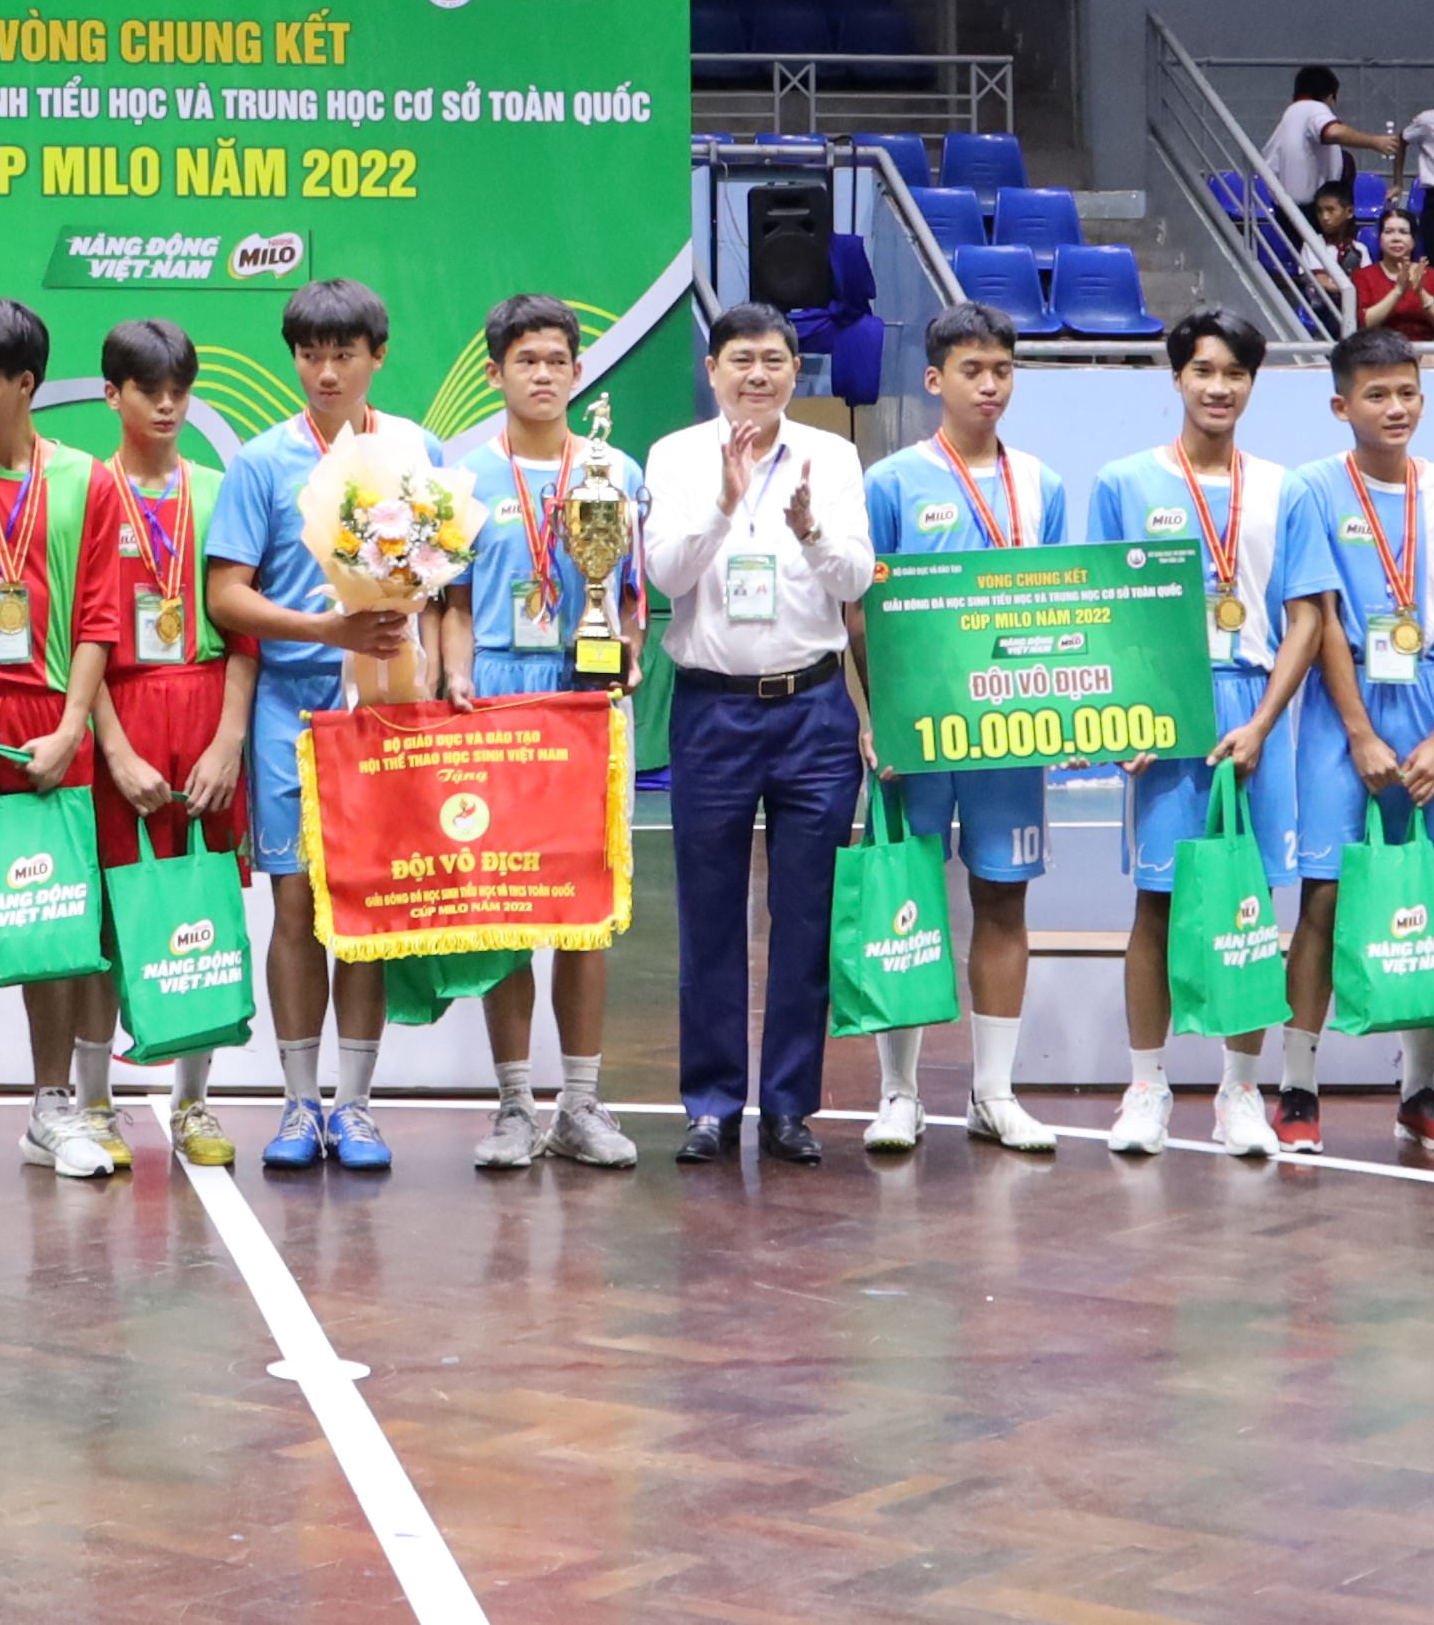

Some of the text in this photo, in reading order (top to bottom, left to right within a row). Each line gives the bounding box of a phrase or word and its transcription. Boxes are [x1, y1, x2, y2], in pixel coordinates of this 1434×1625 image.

[121, 20, 262, 64] CHUNG
[276, 9, 350, 64] KẾT
[36, 77, 100, 118] TIỂU
[109, 88, 167, 125] HỌC
[175, 82, 214, 119] VÀ
[221, 89, 318, 120] TRUNG
[327, 90, 385, 127] HỌC
[394, 88, 434, 121] CƠ
[442, 81, 481, 122] SỞ
[488, 85, 565, 122] TOÀN
[573, 81, 650, 125] QUỐC
[43, 146, 159, 196] MILO
[176, 138, 286, 196] NĂM
[302, 149, 416, 197] 2022
[68, 232, 220, 259] NĂNG ĐỘNG
[239, 246, 295, 268] MILO
[89, 257, 211, 282] VIỆT NAM
[925, 509, 954, 522] MILO
[1152, 514, 1183, 526] MILO
[960, 607, 1111, 630] CÚP MILO NĂM 2022
[971, 665, 1111, 704] ĐỘI VÔ ĐỊCH
[915, 705, 1176, 761] 10.000.000Đ
[1012, 827, 1038, 866] 10
[15, 863, 48, 880] MILO
[391, 847, 541, 881] ĐỘI VÔ ĐỊCH
[36, 883, 88, 904] ĐỘNG
[41, 899, 85, 921] NAM
